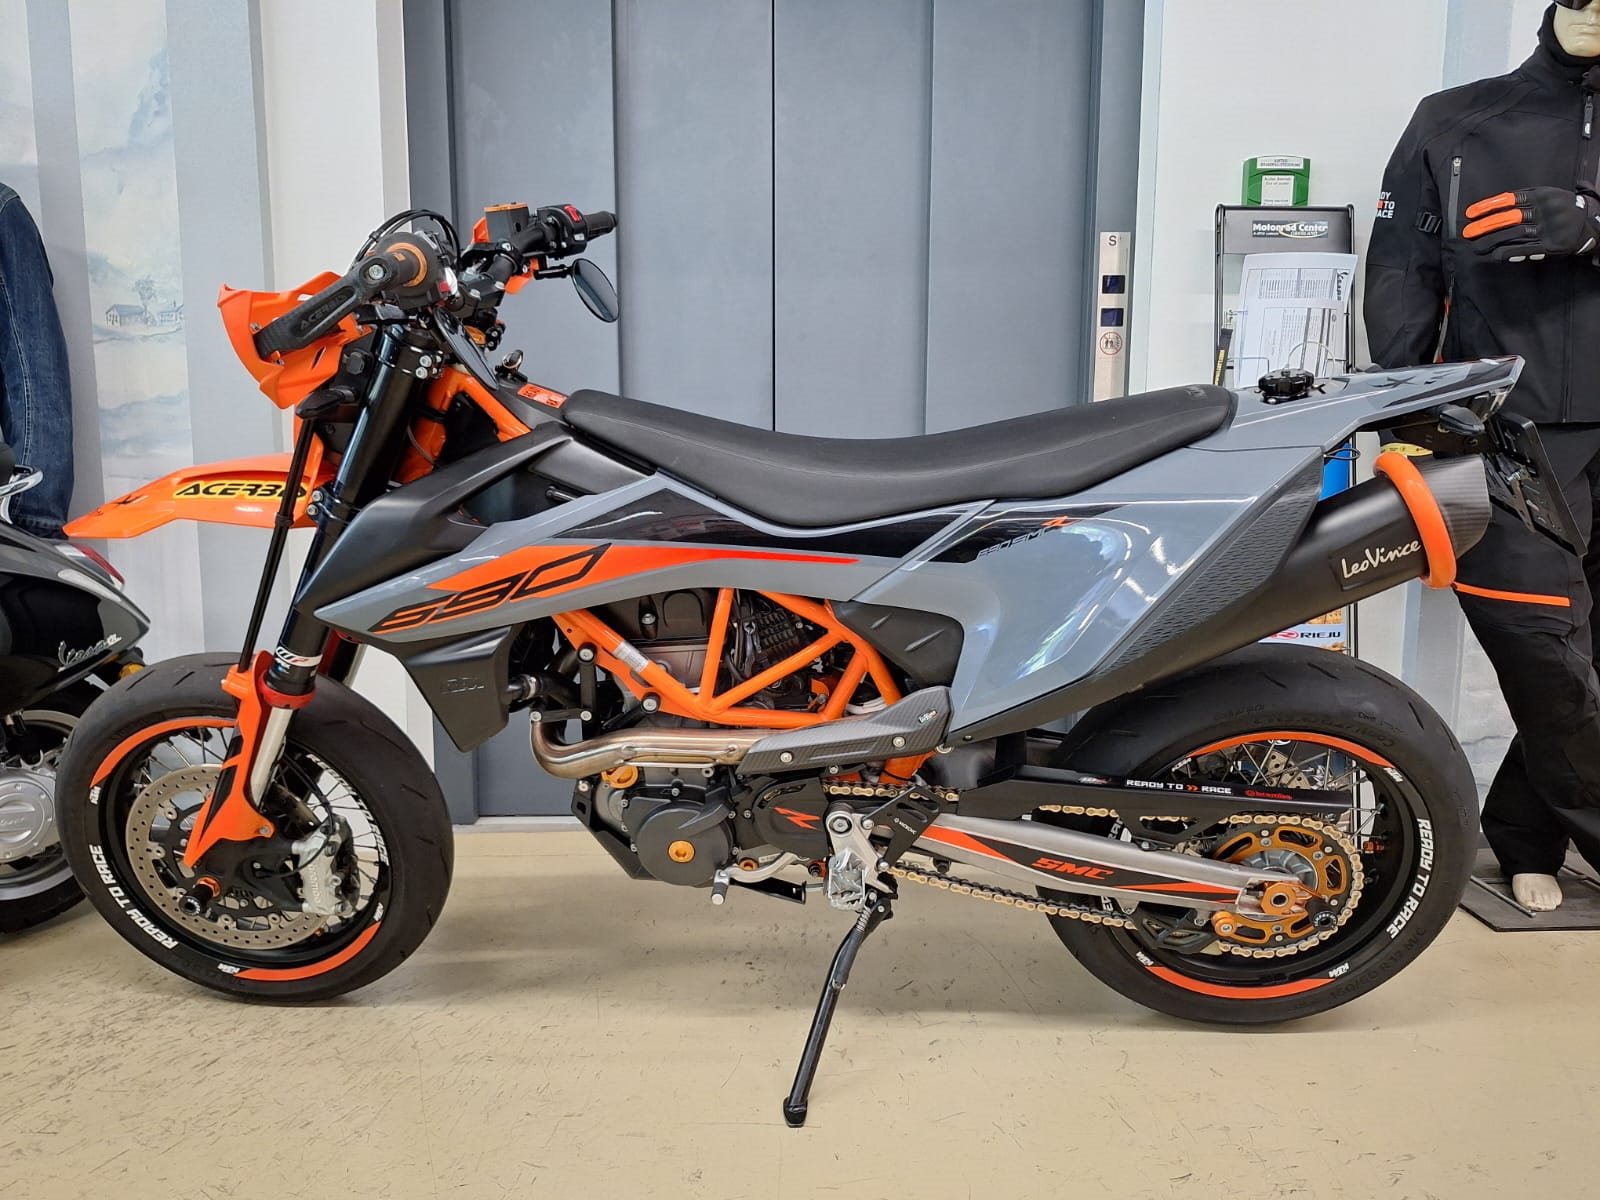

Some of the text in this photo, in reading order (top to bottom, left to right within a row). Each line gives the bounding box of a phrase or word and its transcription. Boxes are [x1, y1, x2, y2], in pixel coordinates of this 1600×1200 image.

[1384, 201, 1395, 209] TO
[1108, 235, 1117, 246] S
[176, 482, 307, 498] ACERB
[1341, 540, 1421, 579] LeoVince
[367, 542, 613, 633] 690
[1300, 631, 1341, 639] RIEJU
[1126, 779, 1164, 789] READY
[1201, 785, 1232, 794] RACE
[1031, 857, 1115, 880] SMC
[1386, 818, 1434, 939] READY TO RACE
[88, 844, 180, 950] READY TO RACE
